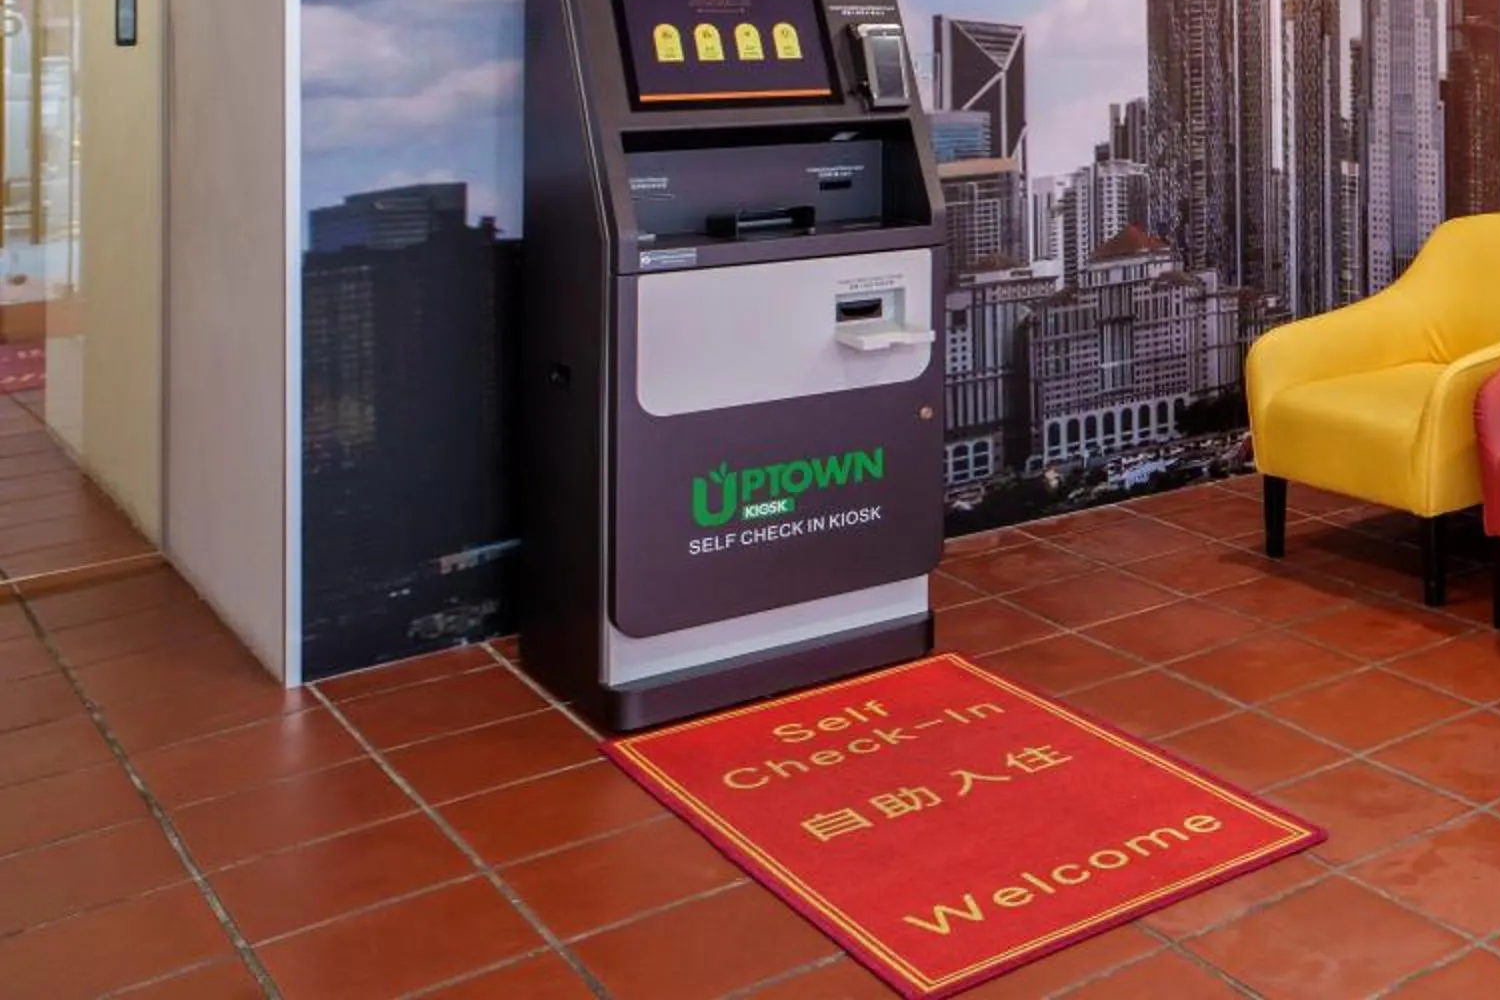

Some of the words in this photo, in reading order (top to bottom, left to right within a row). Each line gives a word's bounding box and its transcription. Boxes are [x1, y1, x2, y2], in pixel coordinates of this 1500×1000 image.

[692, 446, 885, 527] UPTOWN
[744, 499, 788, 519] KIOSK
[688, 532, 738, 556] SELF
[740, 519, 804, 546] CHECK
[807, 515, 825, 533] IN
[828, 505, 882, 529] KIOSK
[722, 701, 1006, 790] Check-In
[772, 699, 891, 743] Self
[799, 744, 1074, 842] 自助入住
[901, 813, 1223, 936] Welcome
